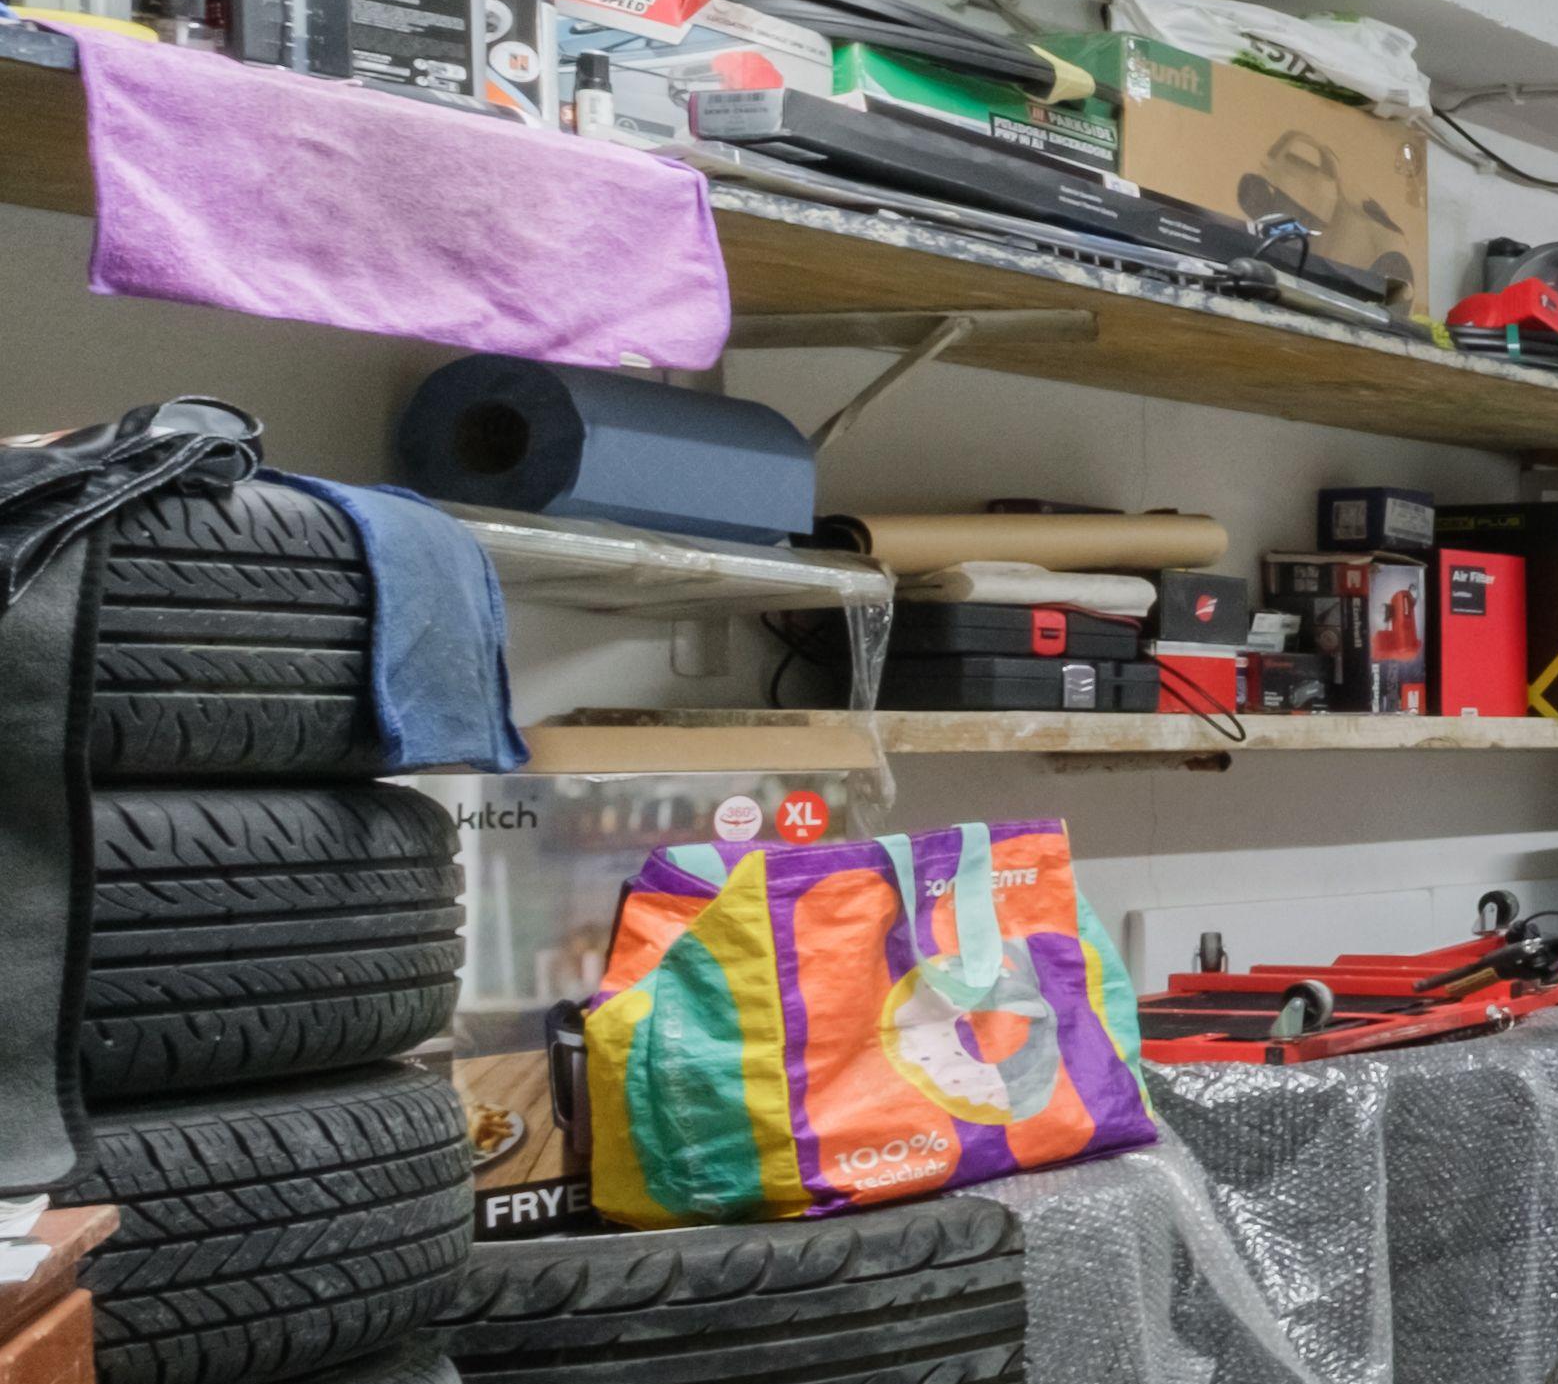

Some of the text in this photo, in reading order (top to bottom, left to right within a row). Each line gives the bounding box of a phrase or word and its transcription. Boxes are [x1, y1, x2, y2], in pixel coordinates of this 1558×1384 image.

[1047, 110, 1113, 142] PARKSIDE
[1452, 569, 1495, 585] Air Filter
[784, 801, 822, 827] XL
[835, 1131, 949, 1174] 100%
[854, 1161, 949, 1191] reciclado
